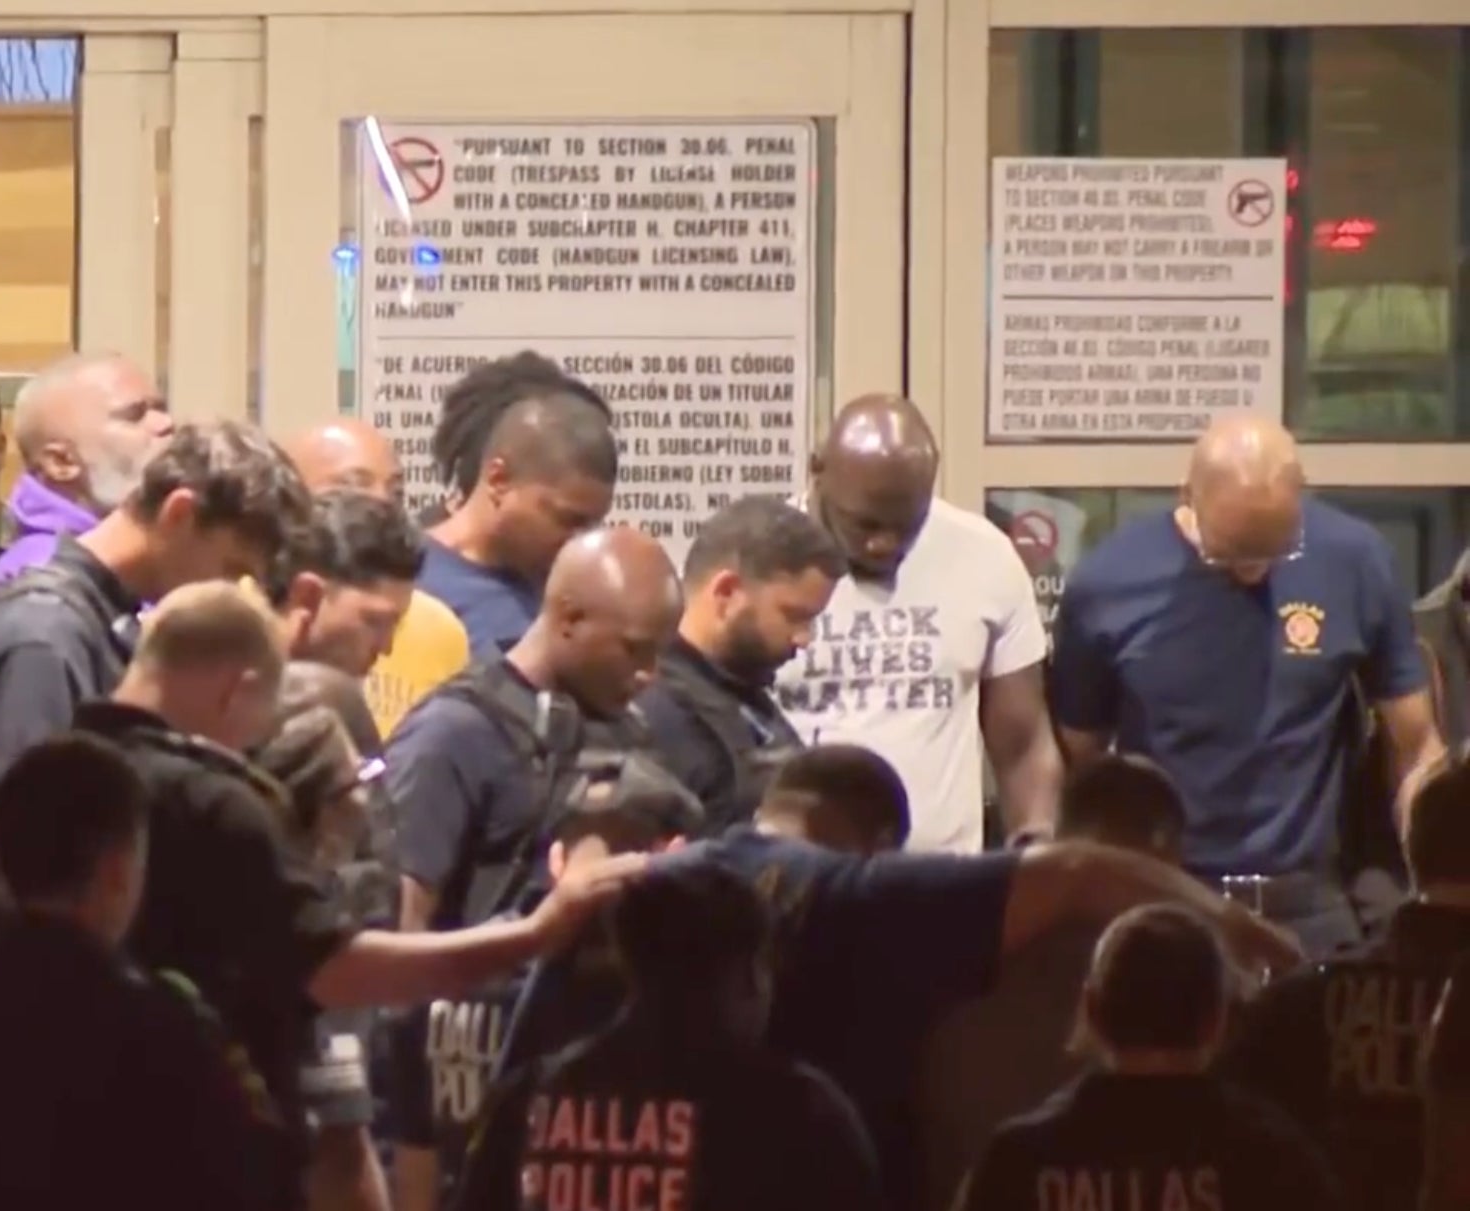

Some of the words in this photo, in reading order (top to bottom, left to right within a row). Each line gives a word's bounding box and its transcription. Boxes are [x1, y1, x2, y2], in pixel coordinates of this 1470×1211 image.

[564, 137, 585, 155] TO
[599, 137, 667, 155] SECTION
[745, 137, 795, 155] PENAL
[453, 165, 495, 183] CODE
[512, 165, 600, 183] (TRESPASS
[614, 165, 634, 183] BY
[651, 165, 714, 183] LICENSE
[731, 165, 796, 183] HOLDER
[1006, 164, 1068, 181] WEAPONS
[1072, 164, 1148, 181] PROHIBITED
[1153, 164, 1223, 181] PURSUANT
[453, 193, 493, 210] WITH
[499, 193, 510, 210] A
[714, 193, 724, 210] A
[731, 193, 796, 210] PERSON
[1005, 189, 1020, 206] TO
[1026, 189, 1078, 206] SECTION
[1127, 189, 1166, 206] PENAL
[1172, 189, 1206, 206] CODE
[462, 220, 517, 237] UNDER
[527, 220, 637, 237] SUBCHAPTER
[673, 220, 749, 237] CHAPTER
[1004, 214, 1056, 231] (PLACES
[1062, 214, 1124, 231] WEAPONS
[497, 247, 539, 265] CODE
[552, 247, 639, 265] (HANDGUN
[652, 247, 738, 265] LICENSING
[1004, 239, 1011, 256] A
[1016, 239, 1067, 256] PERSON
[1072, 239, 1098, 256] MAY
[1104, 239, 1129, 256] NOT
[1133, 239, 1175, 256] CARRY
[1181, 239, 1188, 256] A
[1193, 239, 1250, 256] FIREARM
[1255, 239, 1273, 256] OR
[1004, 263, 1045, 281] OTHER
[1051, 263, 1105, 281] WEAPON
[1109, 263, 1128, 281] ON
[1133, 263, 1161, 281] THIS
[375, 274, 407, 291] MAY
[414, 274, 444, 291] NOT
[451, 274, 499, 291] ENTER
[506, 274, 542, 291] THIS
[548, 274, 633, 291] PROPERTY
[639, 274, 679, 291] WITH
[684, 274, 695, 291] A
[700, 274, 796, 291] CONCEALED
[1004, 315, 1049, 331] ARMAS
[1137, 315, 1208, 331] CONFORME
[1213, 315, 1220, 331] A
[1225, 315, 1240, 331] LA
[1004, 336, 1057, 356] SECCIÓN
[1160, 339, 1198, 356] PENAL
[563, 352, 632, 373] SECCIÓN
[641, 355, 688, 374] 30.06
[695, 355, 722, 374] DEL
[731, 352, 795, 374] CÓDIGO
[1147, 364, 1173, 381] UNA
[1177, 364, 1238, 381] PERSONA
[1242, 364, 1261, 381] NO
[674, 384, 693, 400] DE
[700, 384, 722, 400] UN
[729, 384, 794, 400] TITULAR
[1004, 388, 1044, 406] PUEDE
[1050, 388, 1100, 406] PORTAR
[1104, 388, 1129, 406] UNA
[1134, 388, 1171, 406] ARMA
[1175, 388, 1191, 406] DE
[1195, 388, 1238, 406] FUEGO
[1243, 388, 1251, 406] U
[374, 412, 392, 428] DE
[400, 412, 434, 428] UNA
[761, 412, 794, 428] UNA
[1003, 413, 1036, 430] OTRA
[1041, 413, 1077, 430] ARMA
[1082, 413, 1099, 430] EN
[1103, 413, 1133, 430] ESTA
[635, 438, 650, 455] EL
[658, 433, 773, 455] SUBCAPÍTULO
[619, 465, 693, 483] OBIERNO
[700, 465, 733, 483] (LEY
[741, 465, 794, 483] SOBRE
[616, 493, 695, 511] ISTOLAS),
[640, 520, 673, 538] CON
[1036, 575, 1065, 595] OU
[802, 641, 933, 679] LIVES
[779, 675, 953, 713] MATTER
[427, 999, 503, 1062] DALL
